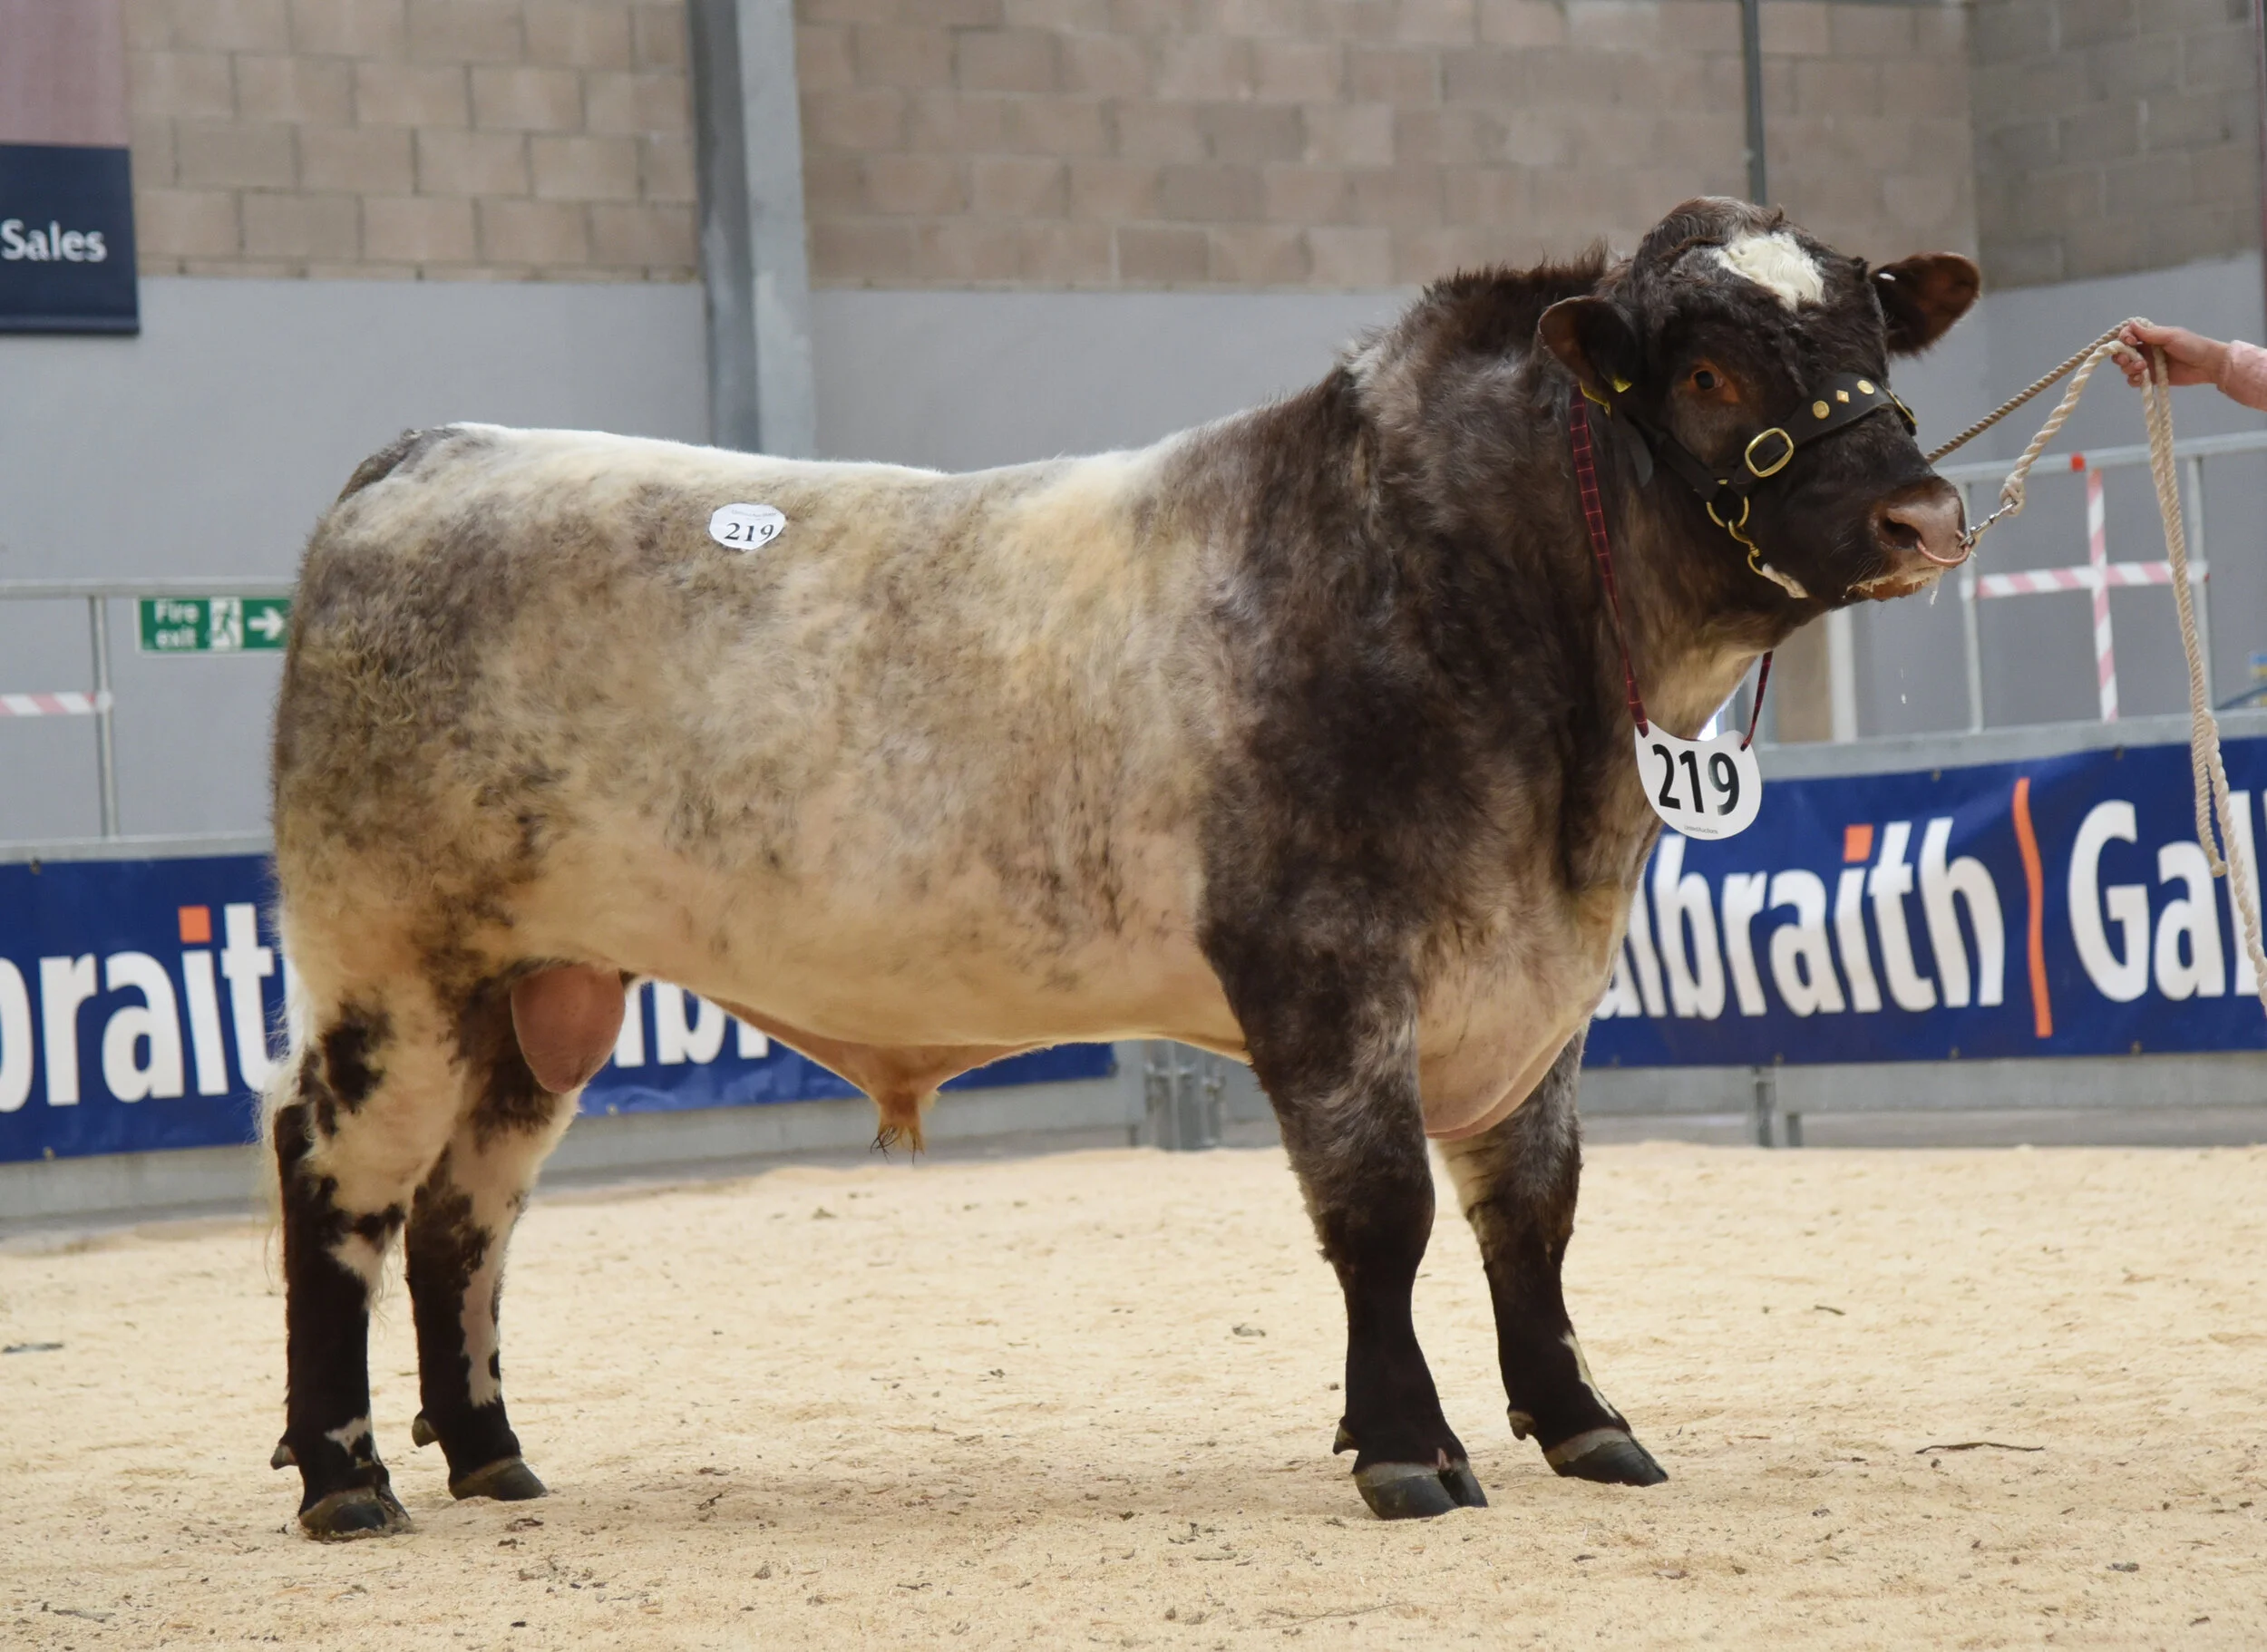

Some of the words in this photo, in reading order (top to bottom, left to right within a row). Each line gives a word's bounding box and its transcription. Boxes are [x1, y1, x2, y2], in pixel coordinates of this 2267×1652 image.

[0, 219, 108, 262] Sales
[724, 522, 774, 542] 219
[153, 598, 200, 624] Fire
[154, 626, 198, 649] exit
[1652, 743, 1740, 816] 219
[2067, 788, 2267, 1004] Gal
[0, 902, 302, 1113] rait
